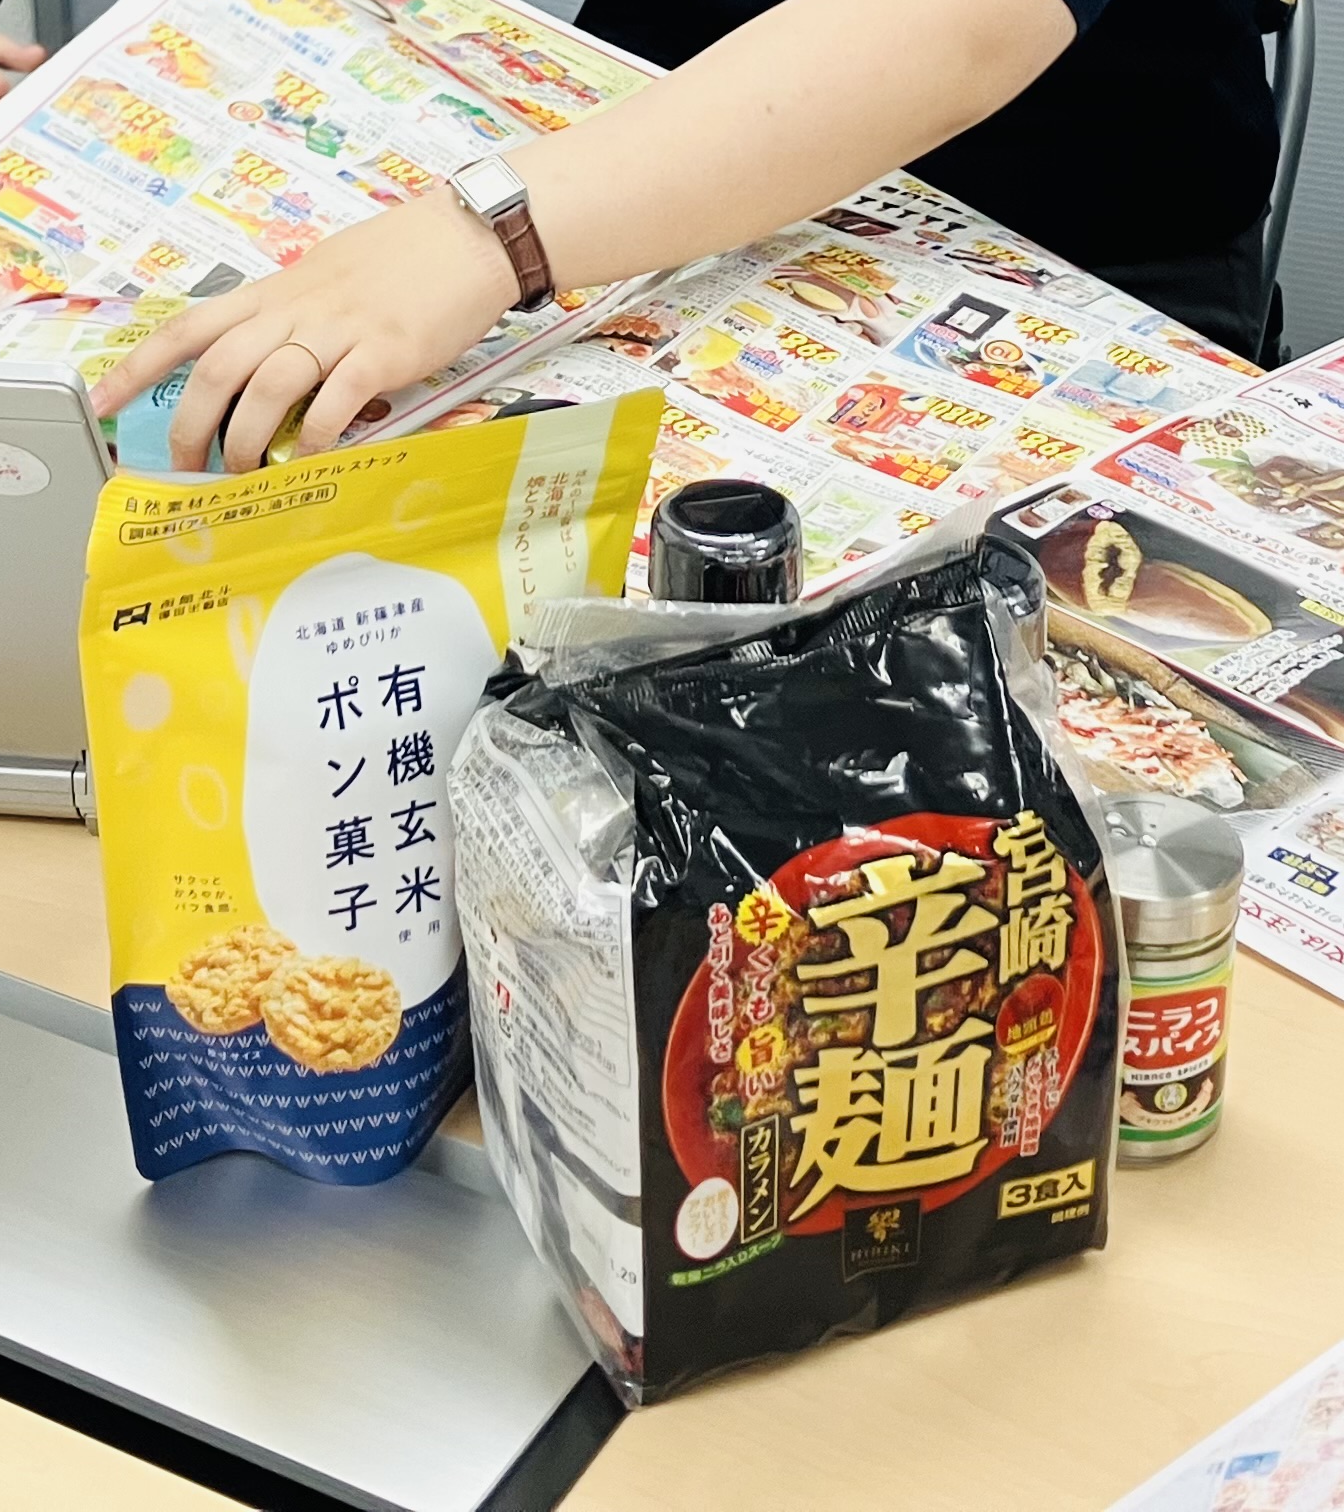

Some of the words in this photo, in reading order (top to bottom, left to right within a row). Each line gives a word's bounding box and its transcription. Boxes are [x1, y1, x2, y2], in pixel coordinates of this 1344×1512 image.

[316, 675, 378, 932] ポン菓子
[378, 663, 442, 915] 有機玄米
[993, 809, 1076, 985] 宮崎
[1123, 1018, 1221, 1058] スパイス
[1127, 997, 1219, 1031] ニラコ
[746, 1126, 773, 1233] カラメン
[1006, 1172, 1087, 1208] 3食入
